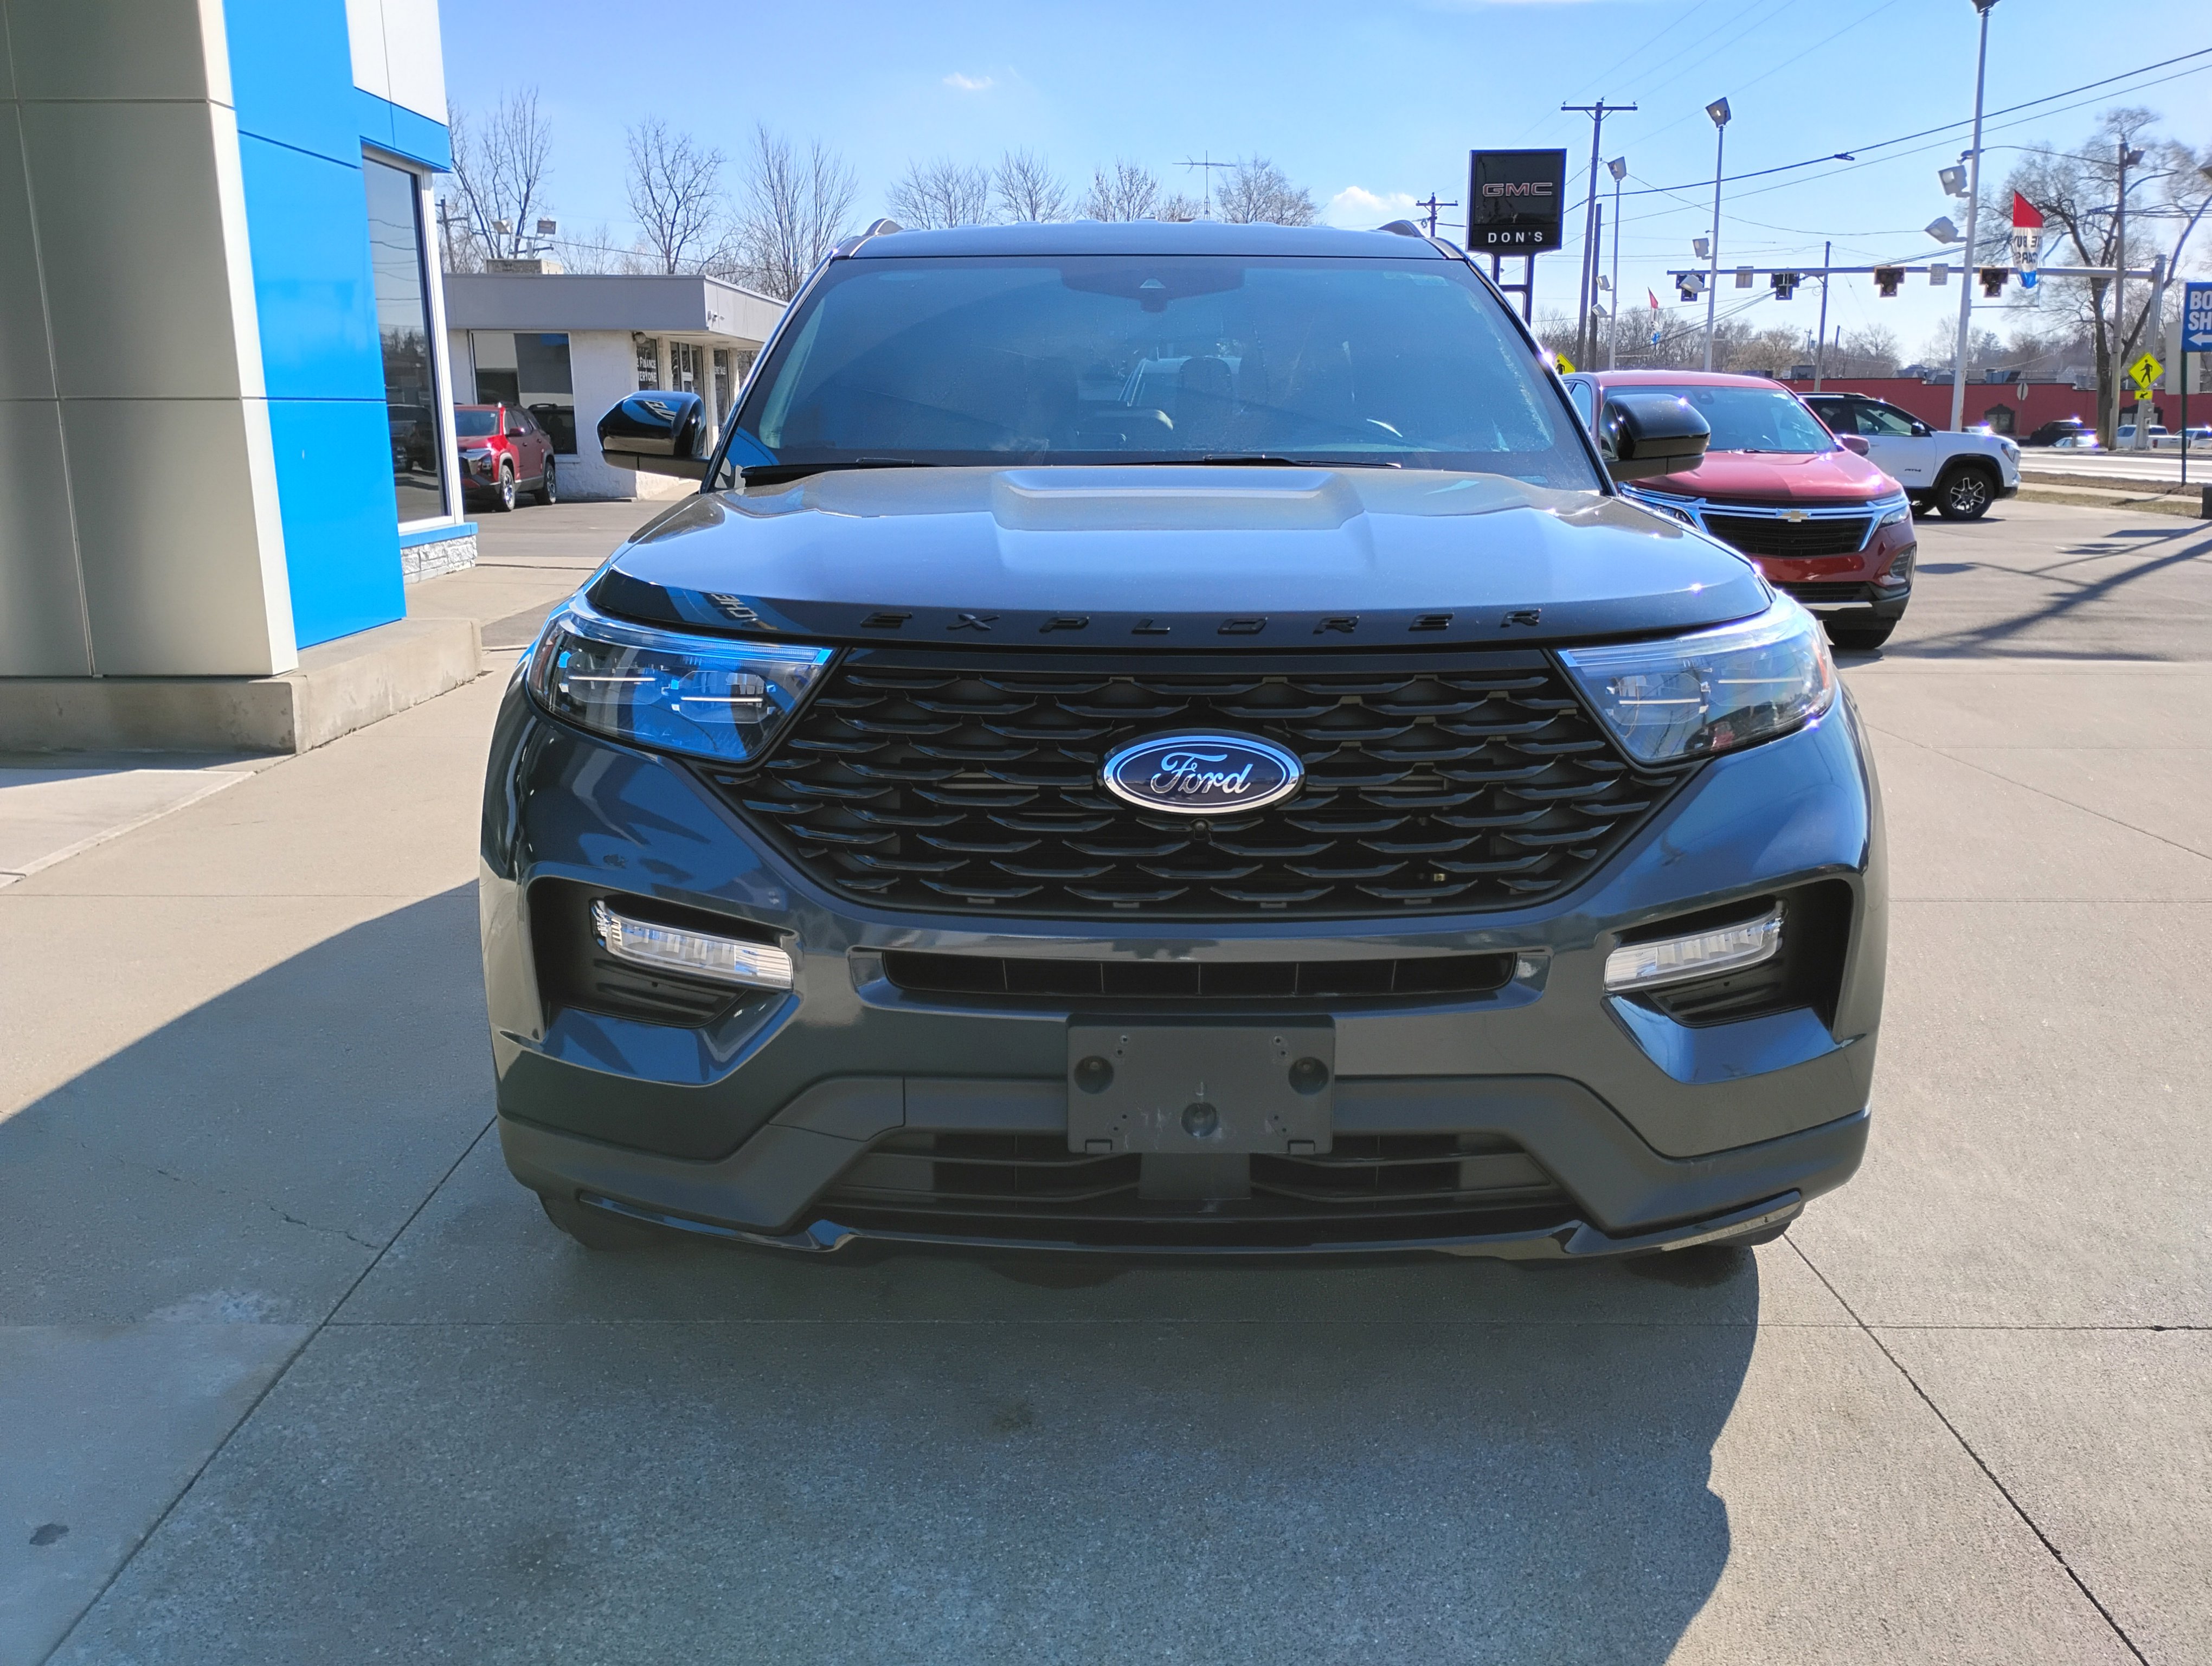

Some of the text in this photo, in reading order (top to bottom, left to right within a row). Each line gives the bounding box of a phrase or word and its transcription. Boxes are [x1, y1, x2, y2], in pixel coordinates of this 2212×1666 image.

[1483, 182, 1552, 196] GMC
[1488, 232, 1542, 243] DON'S
[2188, 311, 2212, 330] SH
[860, 608, 1541, 635] EXPLORER
[1150, 752, 1253, 794] Ford
